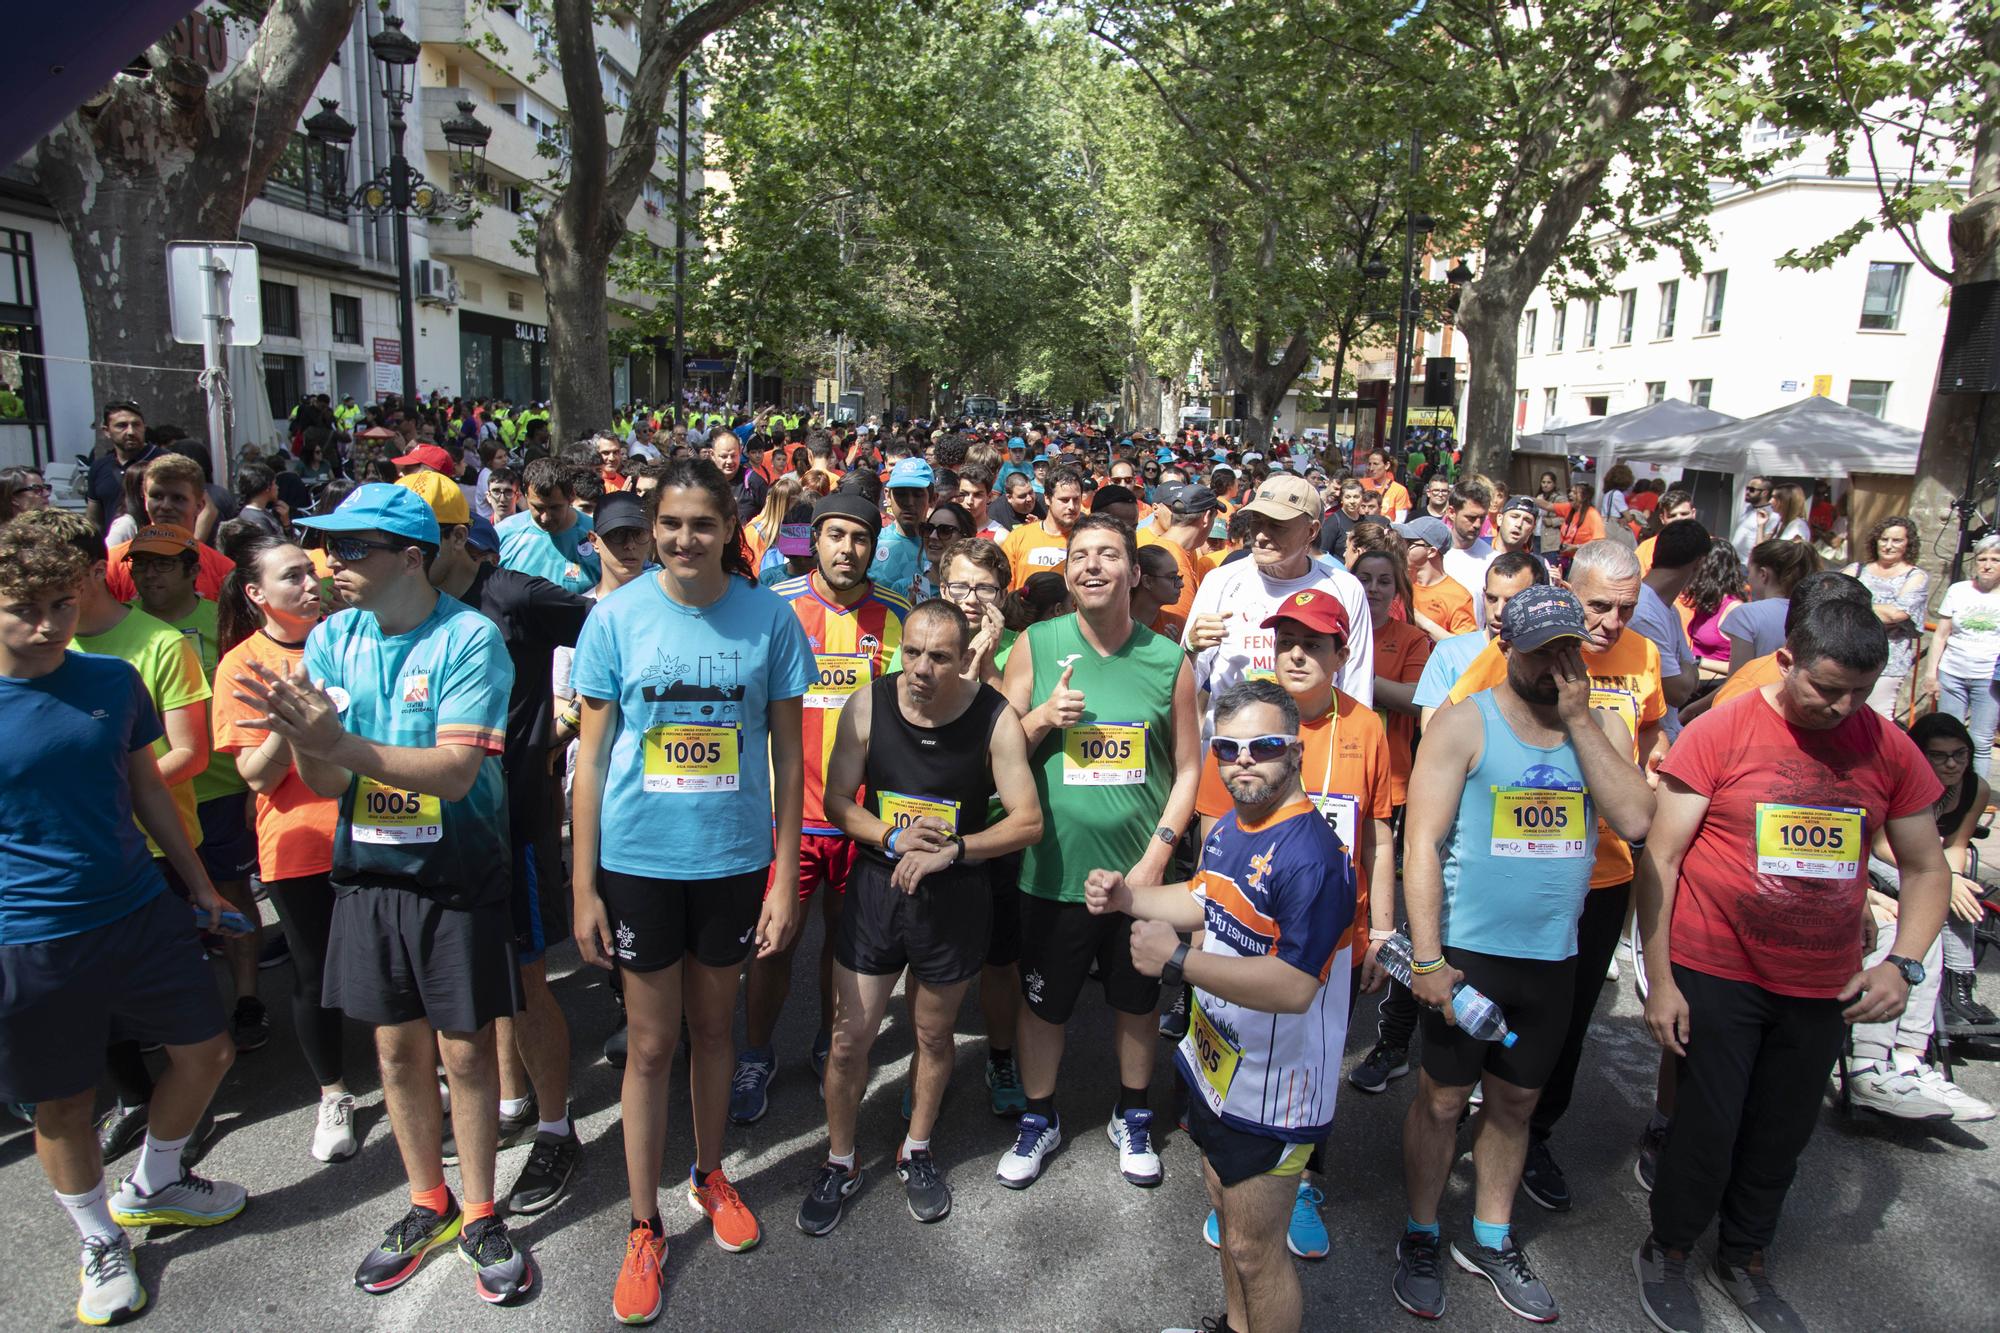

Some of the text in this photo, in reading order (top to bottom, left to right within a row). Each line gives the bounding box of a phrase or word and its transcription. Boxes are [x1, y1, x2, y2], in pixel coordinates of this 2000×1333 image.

[516, 323, 546, 343] SALA DE
[815, 670, 856, 686] 005
[664, 742, 720, 763] 1005
[1081, 740, 1130, 759] 1005
[366, 792, 420, 814] 1005
[894, 812, 922, 829] 10
[1514, 806, 1568, 828] 1005
[1780, 825, 1843, 848] 1005
[1226, 923, 1272, 955] ESPURN
[1194, 1021, 1220, 1073] 1005
